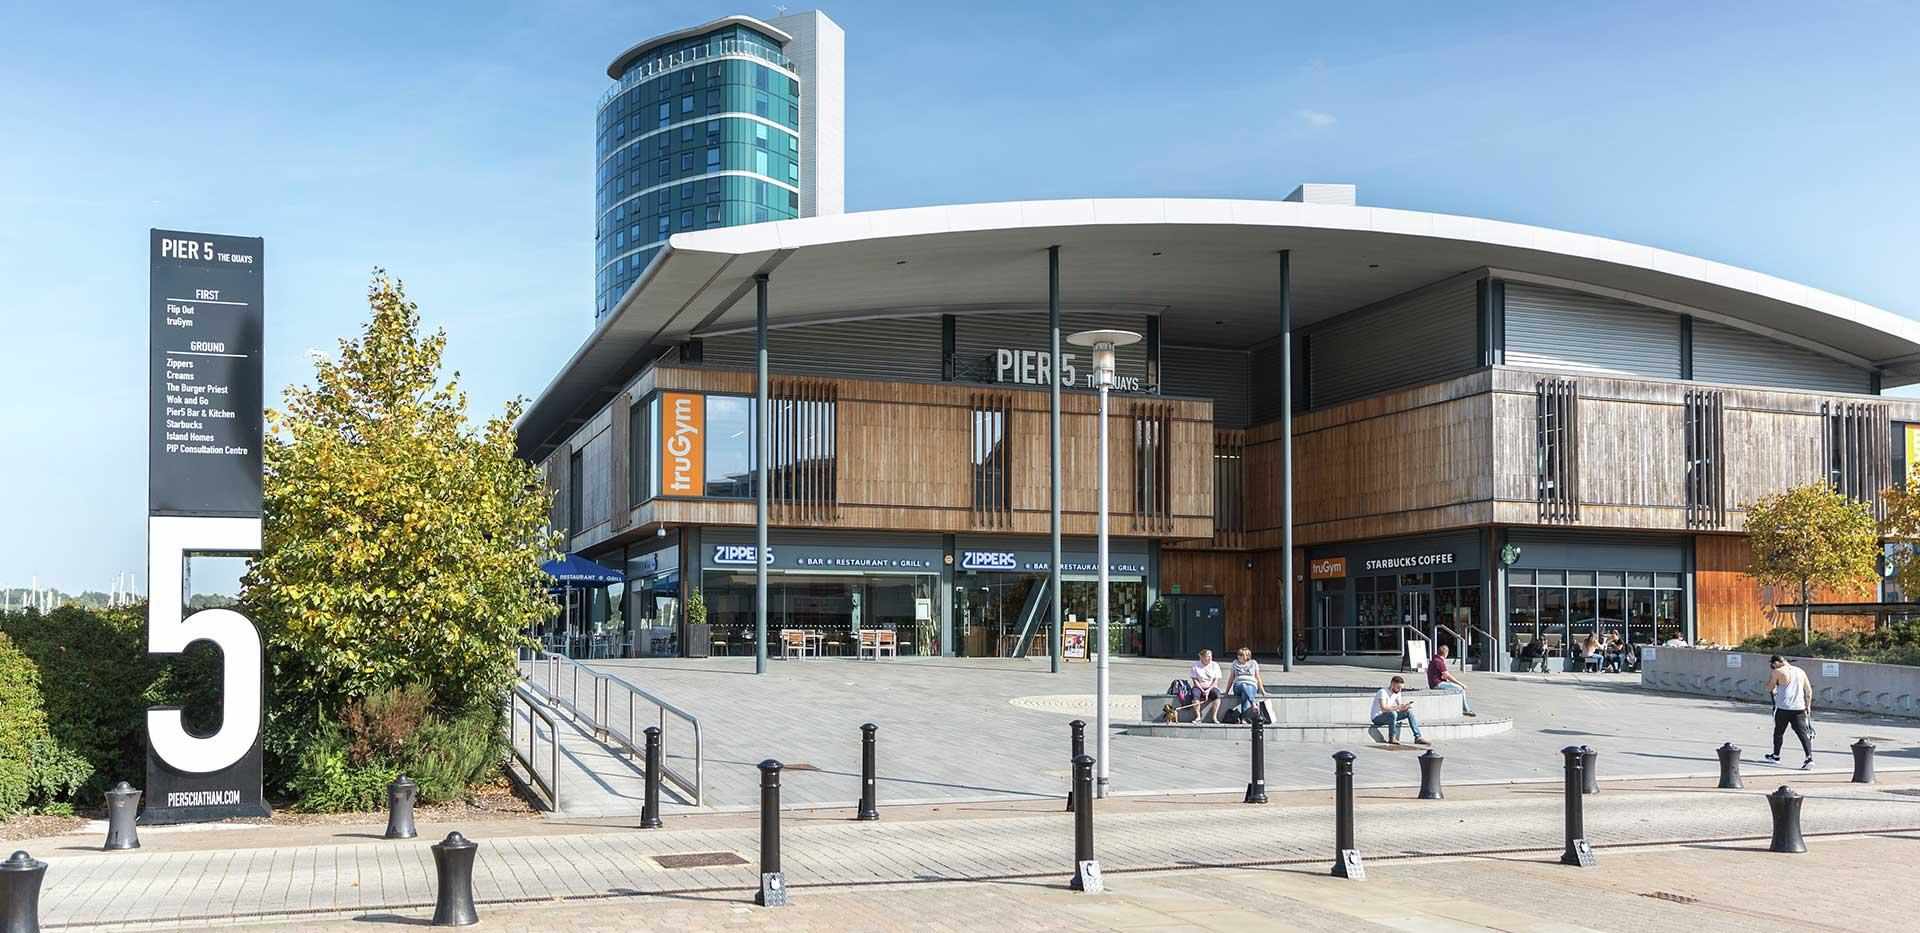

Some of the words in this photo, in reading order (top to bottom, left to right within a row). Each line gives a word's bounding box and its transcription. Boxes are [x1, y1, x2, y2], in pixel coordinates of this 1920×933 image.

[162, 238, 199, 260] PIER
[203, 241, 214, 261] 5
[217, 253, 231, 263] THE
[231, 254, 253, 264] QUAYS
[195, 289, 219, 300] FIRST
[167, 304, 181, 315] Flip
[182, 304, 194, 314] Out
[167, 317, 193, 328] truGym
[190, 341, 225, 352] GROUND
[166, 358, 194, 369] Zippers
[166, 370, 194, 380] Creams
[997, 348, 1051, 385] PIER
[1062, 353, 1076, 386] 5
[1108, 376, 1139, 391] UAYS
[166, 382, 180, 391] The
[181, 384, 206, 395] Burger
[207, 384, 228, 394] Priest
[166, 395, 182, 404] Wok
[184, 396, 198, 405] and
[199, 396, 209, 405] Go
[166, 407, 186, 417] Pier5
[187, 408, 200, 417] Bar
[201, 409, 207, 417] &
[208, 409, 235, 418] Kitchen
[166, 419, 203, 429] Starbucks
[166, 431, 189, 441] Island
[190, 432, 215, 442] Homes
[166, 444, 179, 453] PIP
[180, 444, 224, 454] Consultation
[225, 446, 248, 455] Centre
[667, 399, 698, 490] truGym
[713, 546, 775, 565] ZIPPES
[962, 551, 1017, 569] ZIPPERS
[807, 558, 824, 566] BAR
[835, 558, 888, 567] RESTAURANT
[900, 559, 920, 567] GRILL
[1033, 562, 1048, 570] BAR
[1060, 563, 1099, 571] RESTAURA
[1117, 564, 1137, 572] GRILL
[1366, 555, 1417, 570] STARBUCKS
[1418, 553, 1453, 565] COFFEE
[1312, 561, 1342, 576] truGym
[147, 516, 262, 773] 5
[167, 790, 240, 807] PIER5CHATHAM.COM
